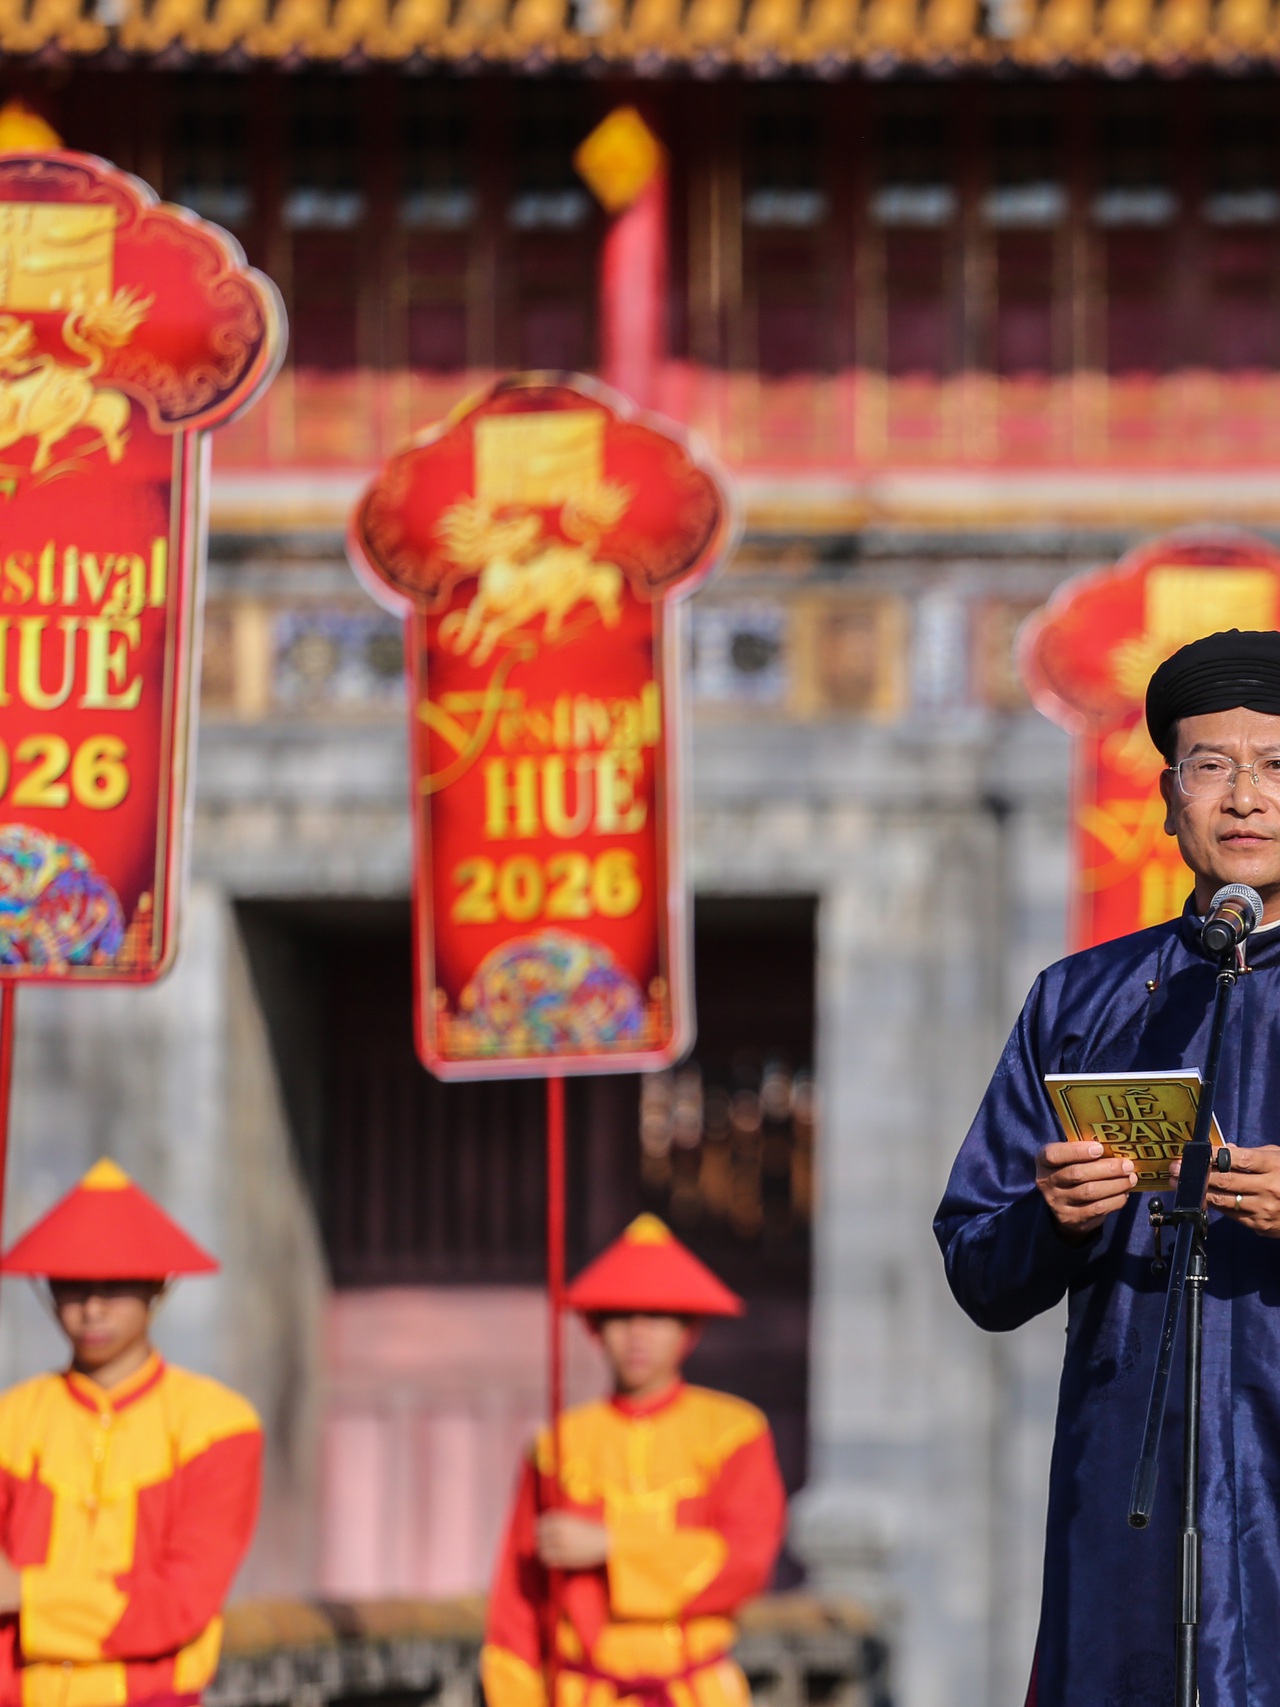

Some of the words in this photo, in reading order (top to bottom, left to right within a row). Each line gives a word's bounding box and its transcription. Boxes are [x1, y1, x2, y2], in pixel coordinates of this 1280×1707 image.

[0, 535, 168, 620] stival
[0, 732, 131, 811] 26
[452, 847, 643, 926] 2026
[1091, 1121, 1193, 1143] BAN
[1098, 1087, 1165, 1121] LỄ
